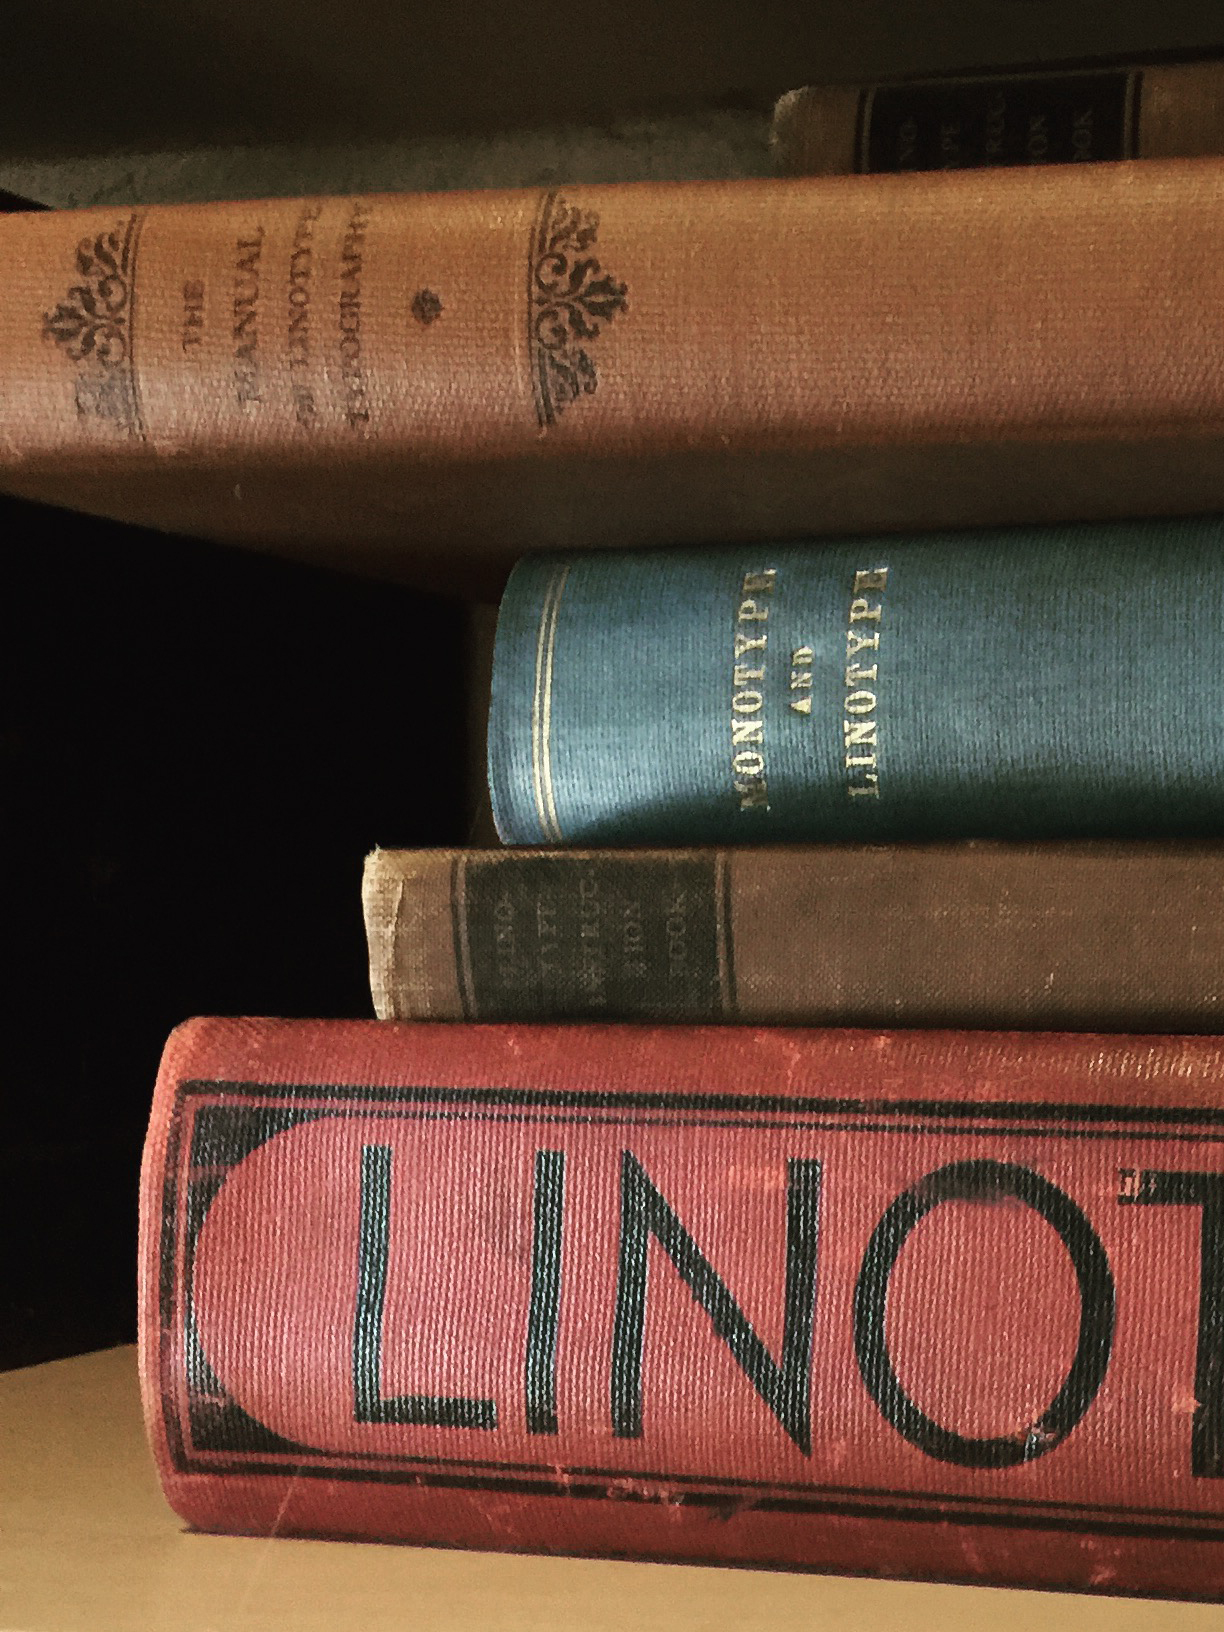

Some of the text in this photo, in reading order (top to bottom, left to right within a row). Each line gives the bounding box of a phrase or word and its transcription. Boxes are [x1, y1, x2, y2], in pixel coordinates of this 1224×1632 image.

[182, 279, 204, 353] THE
[233, 226, 265, 407] MANUAL
[288, 203, 323, 371] LINOTYPE
[338, 202, 371, 431] TYPOGRAPHY
[731, 567, 778, 812] MONOTYPE
[790, 645, 814, 715] AND
[843, 567, 888, 799] LINOTYPE
